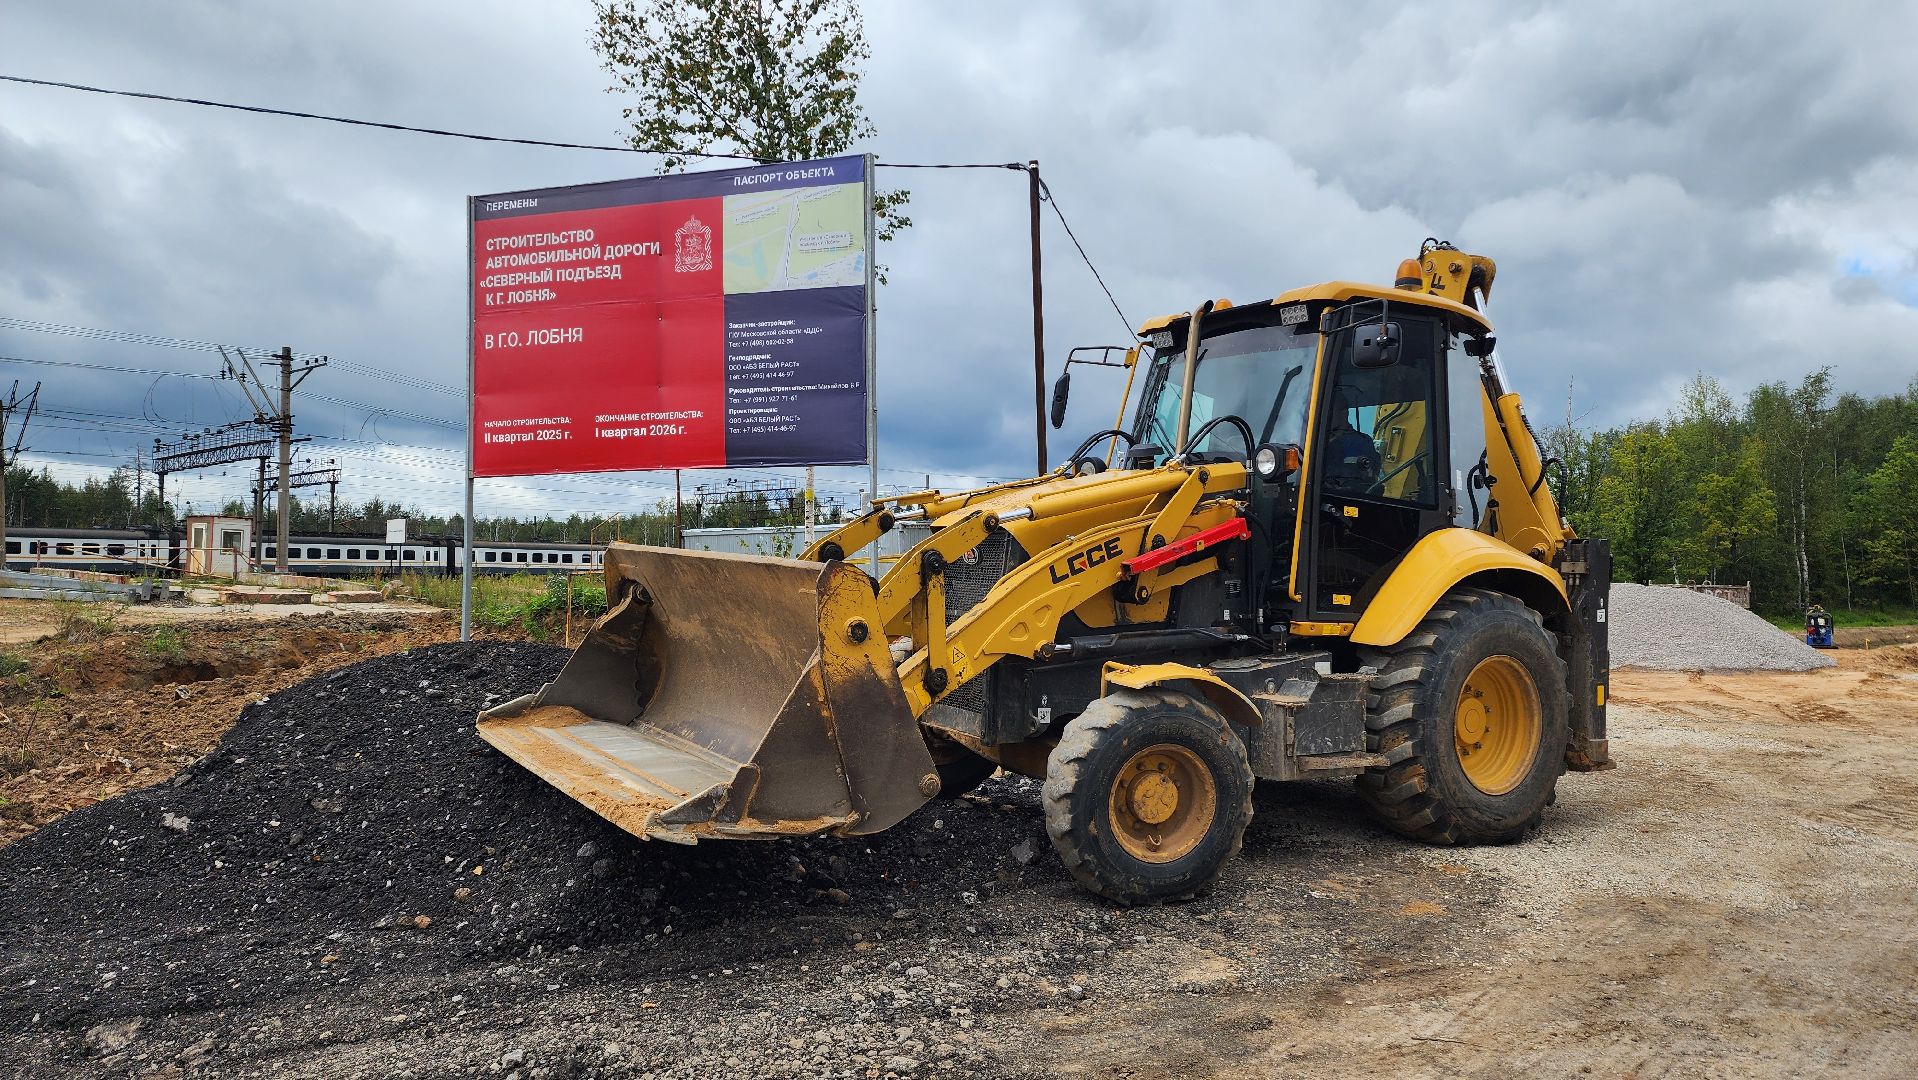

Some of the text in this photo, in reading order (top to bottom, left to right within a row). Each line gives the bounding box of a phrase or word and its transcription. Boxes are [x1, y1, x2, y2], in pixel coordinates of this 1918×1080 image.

[734, 167, 835, 186] ПАСПОРТ ОБЪЕКТА
[486, 198, 538, 212] ПЕРЕМЕНЫ
[486, 228, 594, 251] СТРОИТЕЛЬСТВО
[485, 241, 661, 269] АВТОМОБИЛЬНОЙ ДОРОГИ
[479, 264, 622, 288] «СЕВЕРНЫЙ ПОДЪЕЗД
[486, 288, 557, 306] К Г. ЛОБНЯ»
[485, 327, 583, 349] В Г.О. ЛОБНЯ
[778, 328, 802, 336] области
[758, 361, 780, 369] БЕЛЫЙ
[485, 416, 572, 428] НАЧАЛО СТРОИТЕЛЬСТВА:
[595, 410, 704, 423] ОКОНЧАНИЕ СТРОИТЕЛЬСТВА:
[758, 415, 781, 423] БЕЛЫЙ
[484, 429, 573, 445] II квартал 2025 г.
[601, 427, 647, 440] квартал
[649, 424, 677, 436] 2026
[678, 425, 688, 435] г.
